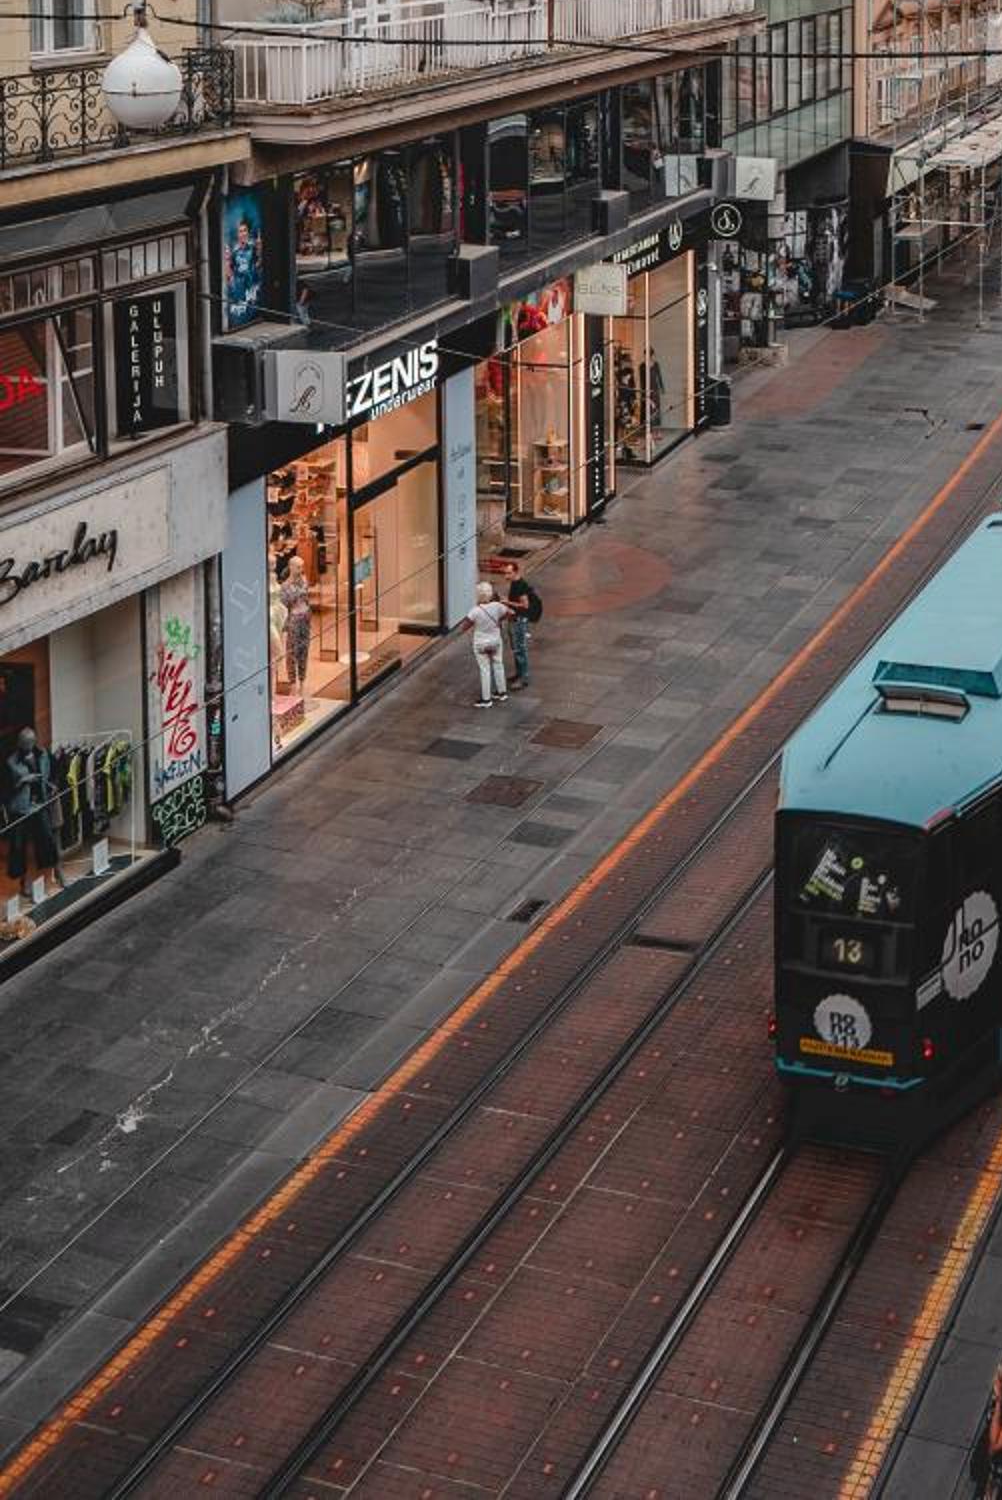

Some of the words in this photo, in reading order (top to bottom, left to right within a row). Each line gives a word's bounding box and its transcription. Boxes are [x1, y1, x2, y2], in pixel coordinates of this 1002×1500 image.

[129, 305, 143, 422] GALERIJA
[317, 339, 438, 434] ZENIS
[0, 521, 118, 603] Barclay
[834, 938, 862, 963] 13
